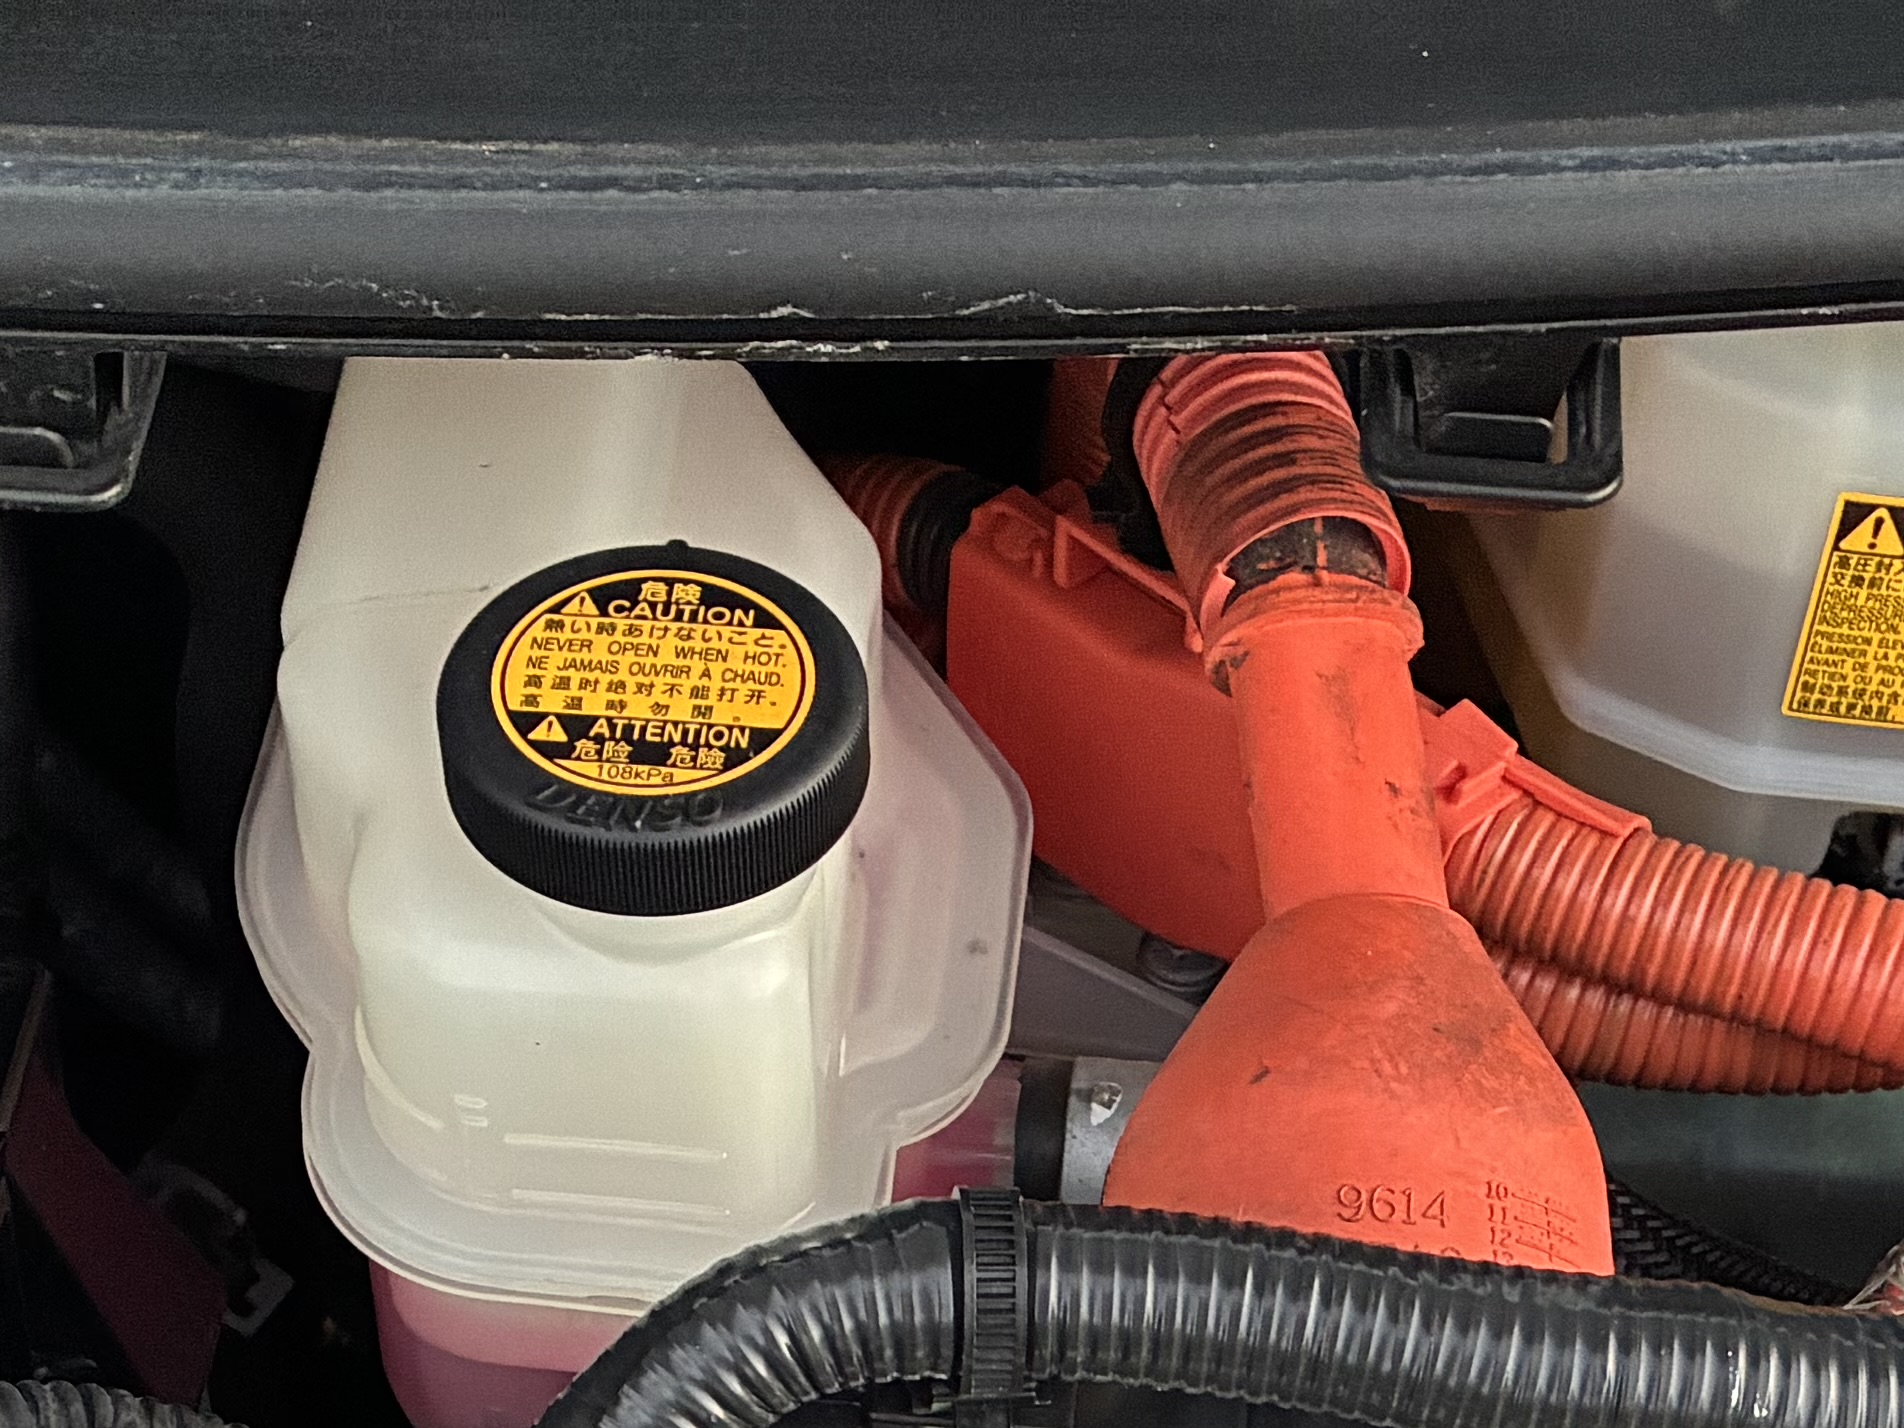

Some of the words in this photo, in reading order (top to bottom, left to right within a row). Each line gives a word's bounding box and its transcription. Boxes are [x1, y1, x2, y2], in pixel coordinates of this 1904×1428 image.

[638, 580, 702, 604] 危険
[1823, 588, 1859, 602] HIGH
[607, 599, 754, 627] CAUTION
[530, 636, 593, 653] NEVER
[607, 641, 659, 658] OPEN
[674, 646, 729, 663] WHEN
[743, 651, 786, 668] HOT.
[1872, 651, 1889, 660] LA
[526, 655, 548, 670] NE
[556, 657, 619, 674] JAMAIS
[628, 662, 690, 680] OUVRIR
[698, 662, 711, 681] À
[721, 668, 783, 687] CHAUD.
[1806, 656, 1846, 668] AVANT
[1851, 661, 1869, 671] DE
[1852, 674, 1874, 684] OU
[1876, 677, 1896, 686] AU
[589, 717, 750, 748] ATTENTION
[596, 764, 674, 782] 108kPa
[1486, 1180, 1508, 1201] 10
[1336, 1183, 1447, 1229] 9614
